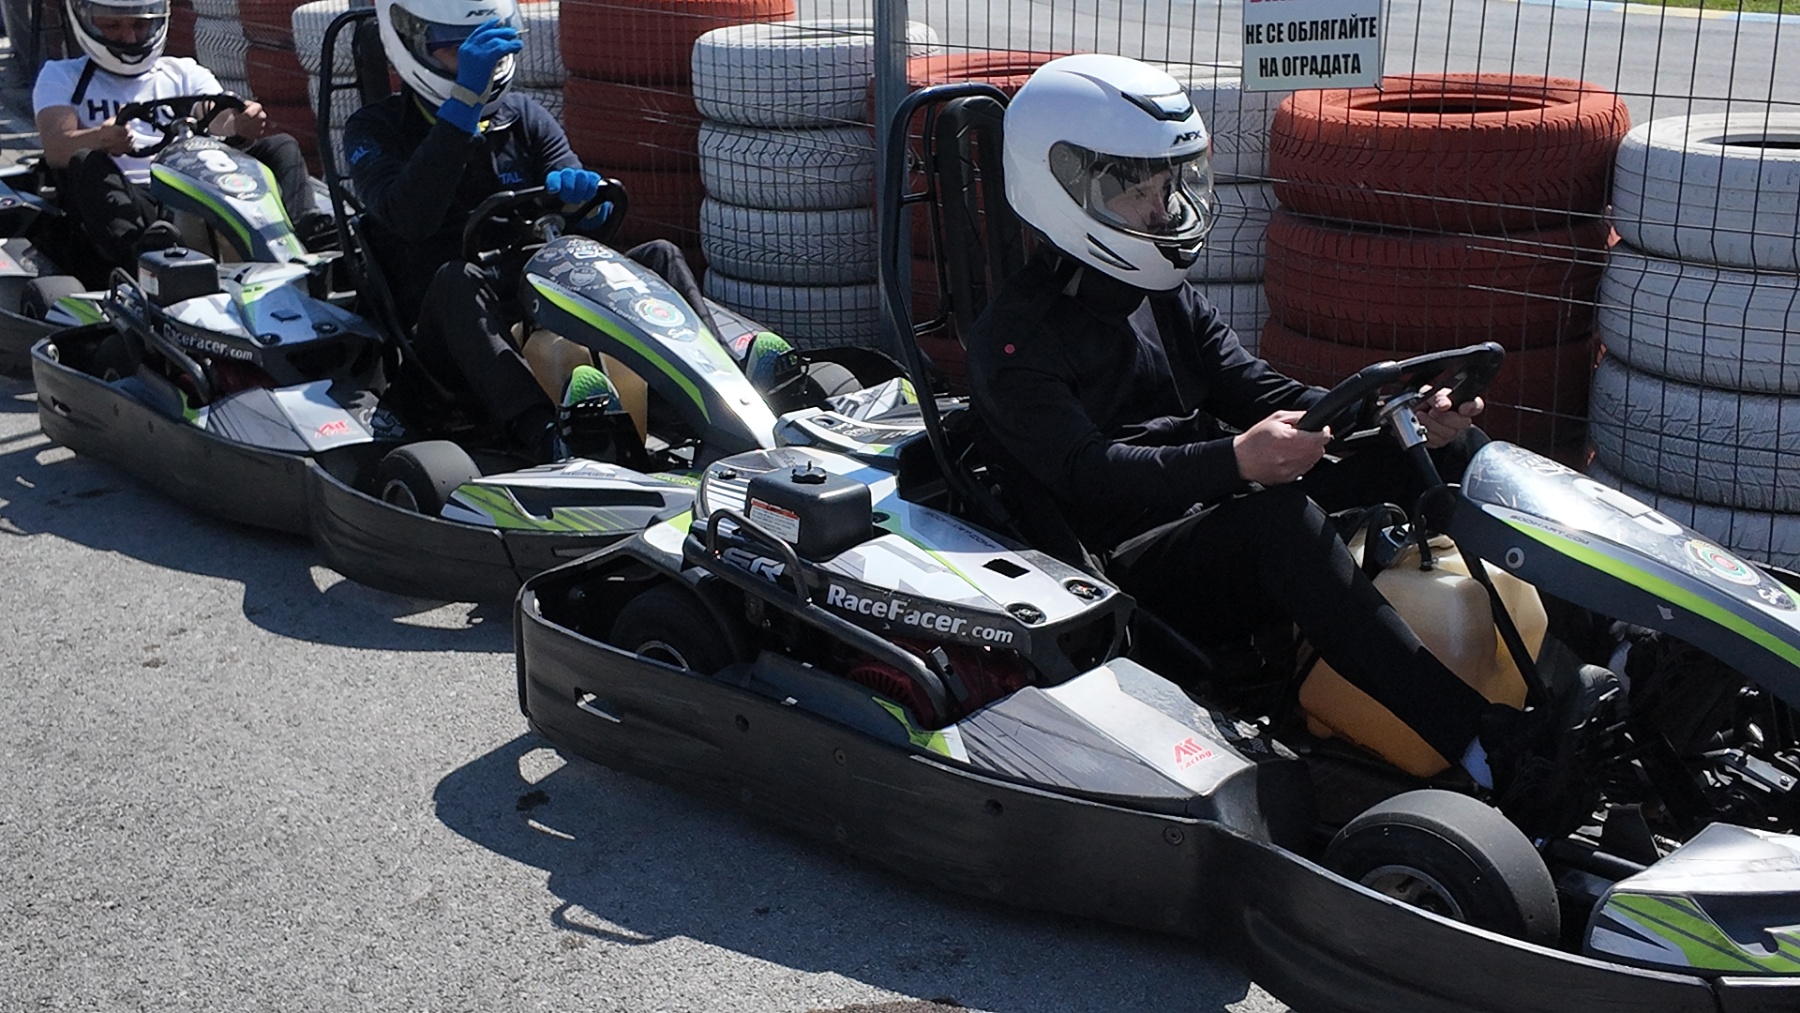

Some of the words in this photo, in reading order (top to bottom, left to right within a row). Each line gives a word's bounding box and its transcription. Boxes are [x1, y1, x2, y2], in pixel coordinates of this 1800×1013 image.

[1246, 24, 1263, 45] НЕ
[1266, 23, 1284, 43] СЕ
[1287, 13, 1377, 42] ОБЛЯГАЙТЕ
[1259, 57, 1279, 78] НА
[1282, 53, 1361, 78] ОГРАДАТА
[1171, 130, 1202, 147] AFX
[826, 583, 1014, 644] RaceFacer.com
